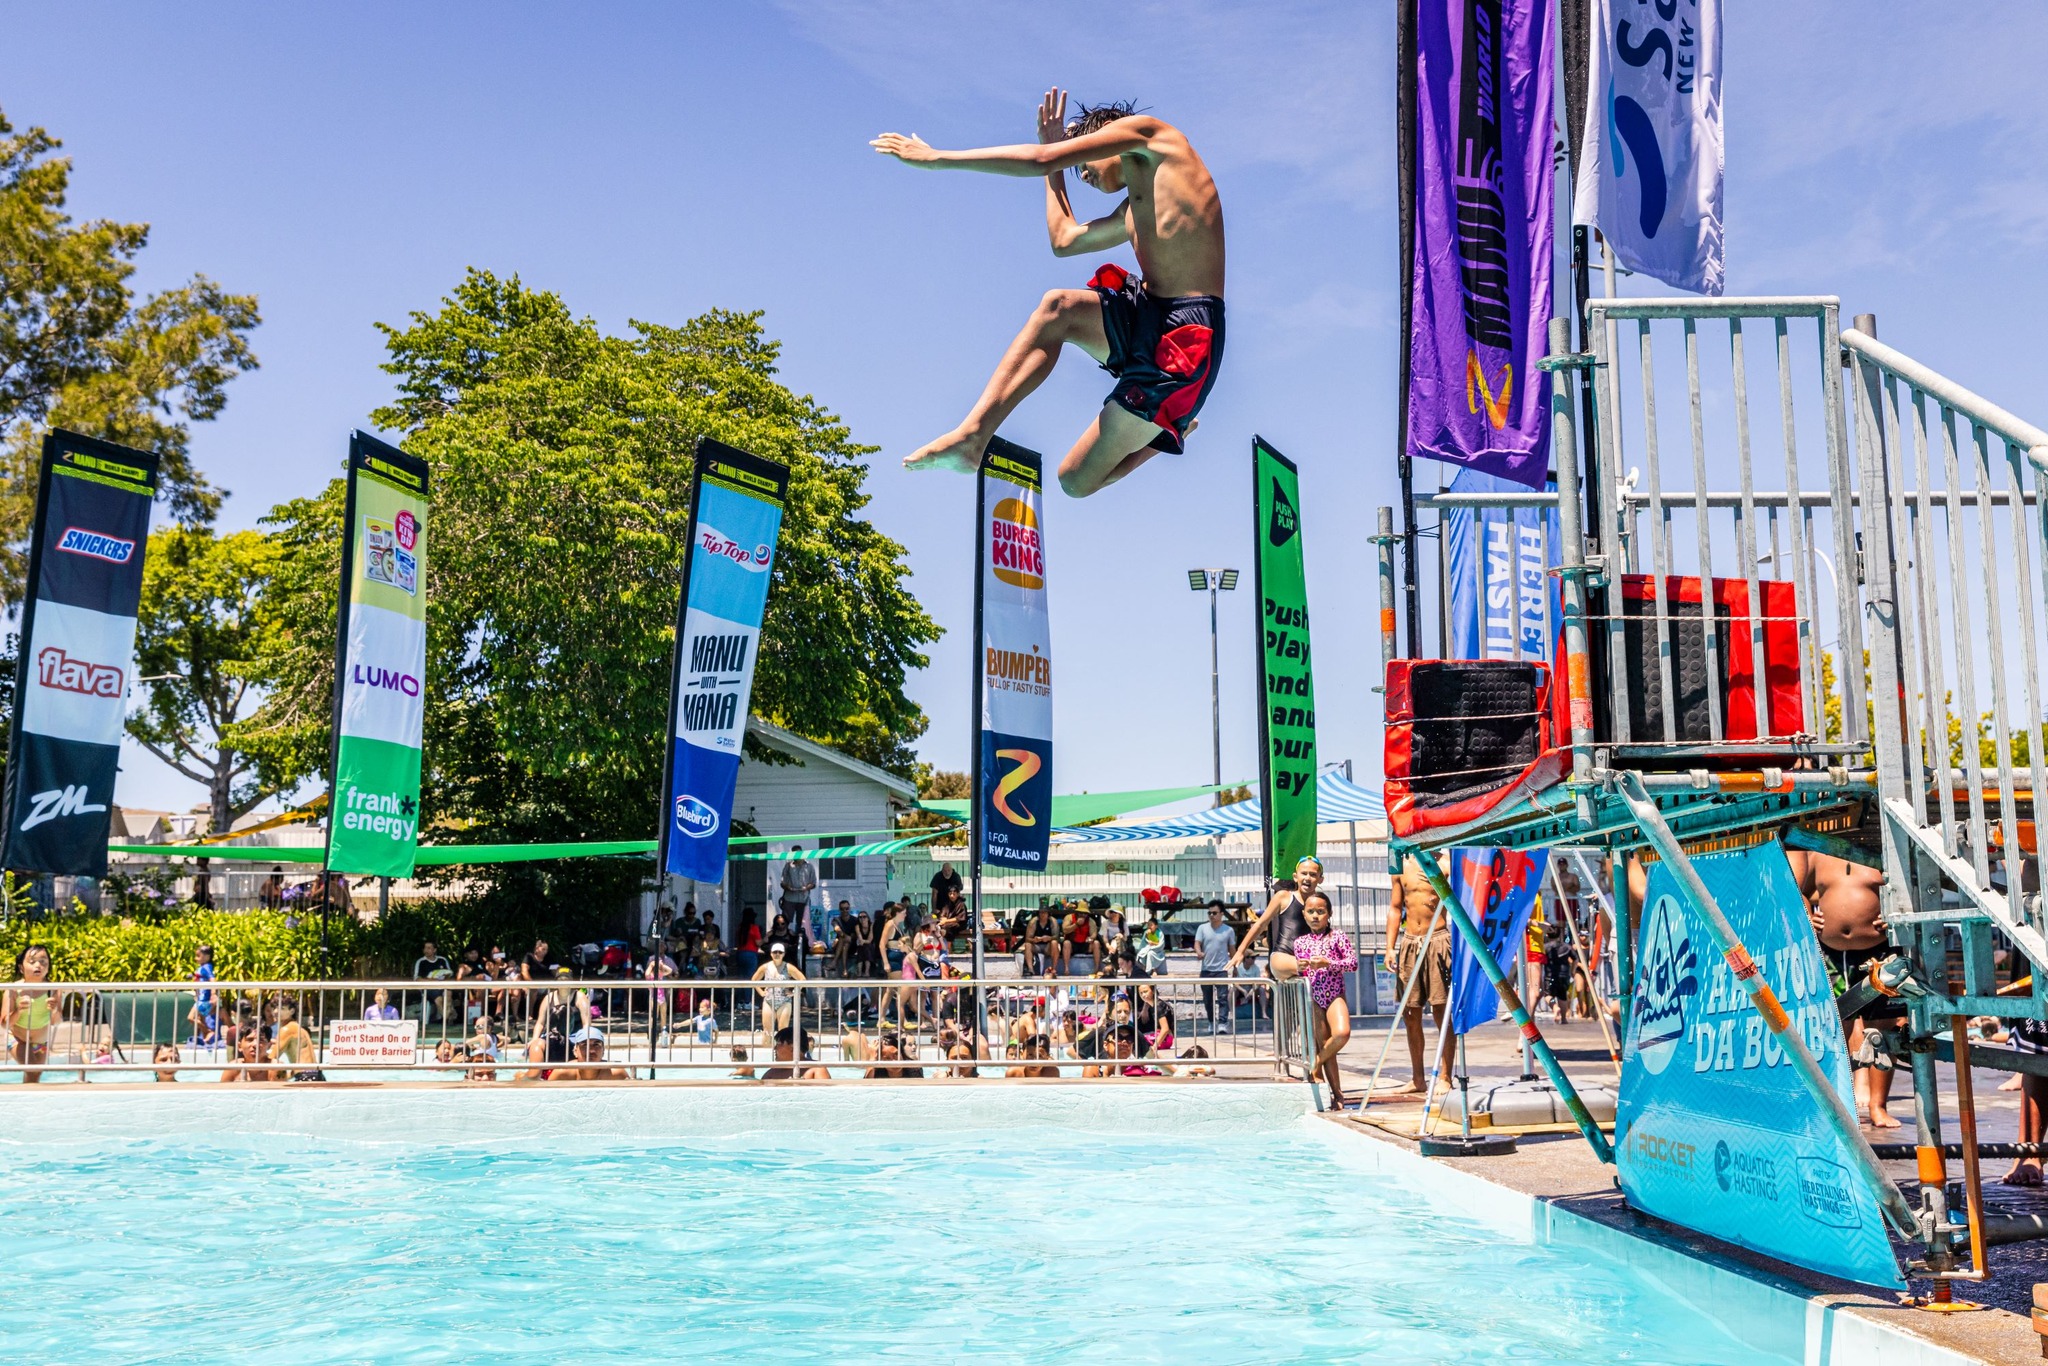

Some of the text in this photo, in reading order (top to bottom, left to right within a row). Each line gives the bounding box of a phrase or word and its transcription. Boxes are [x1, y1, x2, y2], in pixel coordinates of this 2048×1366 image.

[1476, 4, 1495, 126] WORLD
[1676, 16, 1694, 94] NEW
[1456, 182, 1513, 351] MANU
[1277, 514, 1294, 531] PLAY
[60, 528, 134, 562] SNICKERS
[702, 533, 750, 563] Tip Top
[992, 539, 1043, 576] KING
[690, 634, 749, 673] MANU
[987, 647, 1050, 687] BUMPER
[39, 648, 123, 698] flava
[354, 664, 419, 697] LUMO
[700, 676, 718, 690] WITH
[987, 677, 1050, 698] FULL OF TASTY STUFF
[683, 692, 738, 731] MANA
[1270, 706, 1315, 729] anu
[1275, 770, 1310, 797] ay
[20, 784, 107, 832] ZM
[677, 804, 712, 827] Bluebird
[343, 811, 415, 842] energy
[1004, 847, 1041, 862] ZALAND
[1774, 936, 1817, 1003] YOU
[334, 1034, 357, 1043] Don't
[359, 1034, 384, 1043] Stand
[387, 1034, 399, 1043] On
[337, 1023, 367, 1033] Please
[359, 1047, 379, 1056] Over
[1638, 1132, 1696, 1168] ROCKET
[1733, 1151, 1776, 1180] AQUATICS
[1734, 1173, 1779, 1202] HASTINGS
[1801, 1179, 1852, 1203] HERETAUNGA
[1803, 1193, 1840, 1215] HASTINGS
